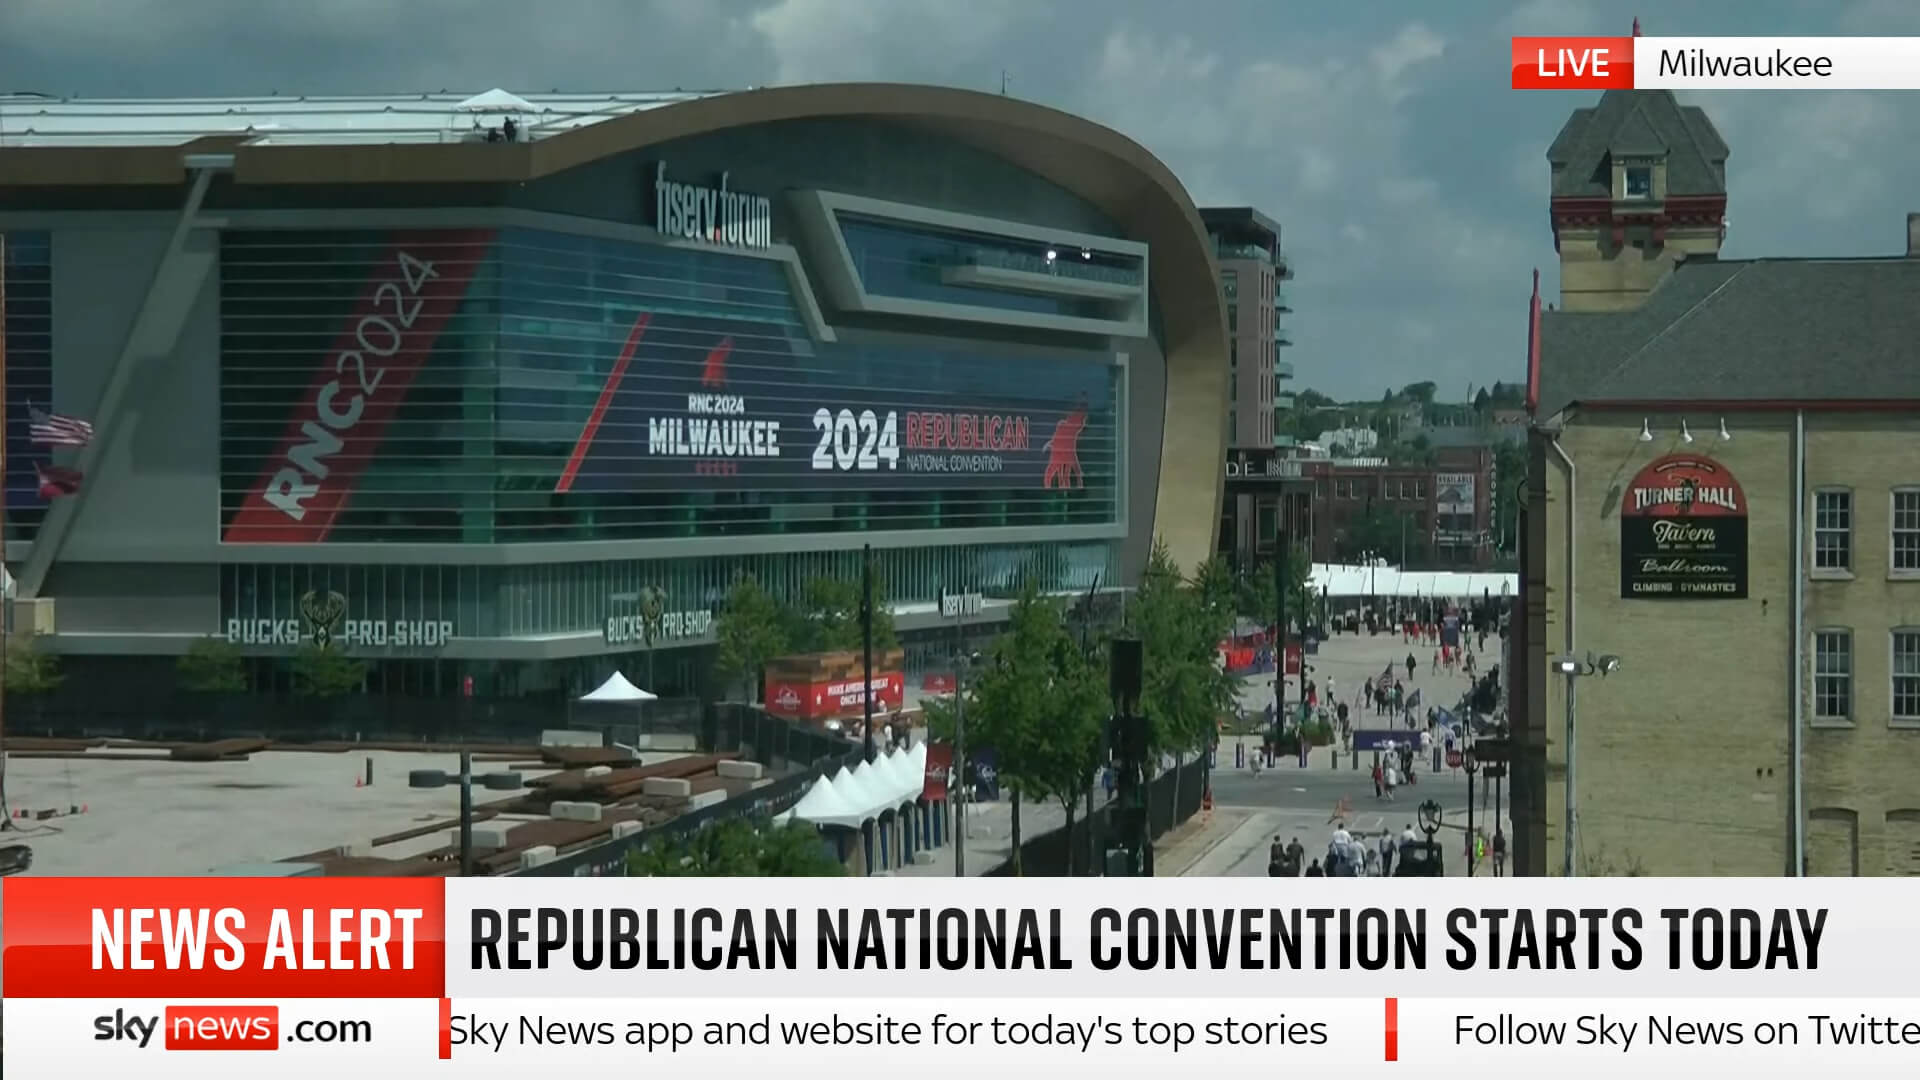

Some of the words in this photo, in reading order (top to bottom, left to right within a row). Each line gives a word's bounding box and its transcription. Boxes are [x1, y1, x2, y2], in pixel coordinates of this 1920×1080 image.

[263, 251, 439, 520] RNC2024
[649, 417, 780, 457] MILWAUKEE
[812, 408, 899, 470] 2024
[906, 411, 1029, 451] REPUBLICAN
[906, 454, 948, 471] NATIONAL
[950, 455, 1002, 472] CONVENTION
[1634, 487, 1694, 510] TURNER
[1698, 487, 1737, 511] HALL
[1652, 520, 1715, 543] Tavern
[1640, 558, 1728, 573] Ballroom
[1632, 582, 1673, 593] CLIMBING
[1680, 582, 1736, 593] GYMNASTICS
[227, 618, 300, 644] BUCKS
[345, 620, 388, 645] PRO
[395, 620, 454, 646] SHOP
[607, 615, 644, 642] BUCKS
[663, 611, 683, 639] PRO
[685, 609, 711, 636] SHOP
